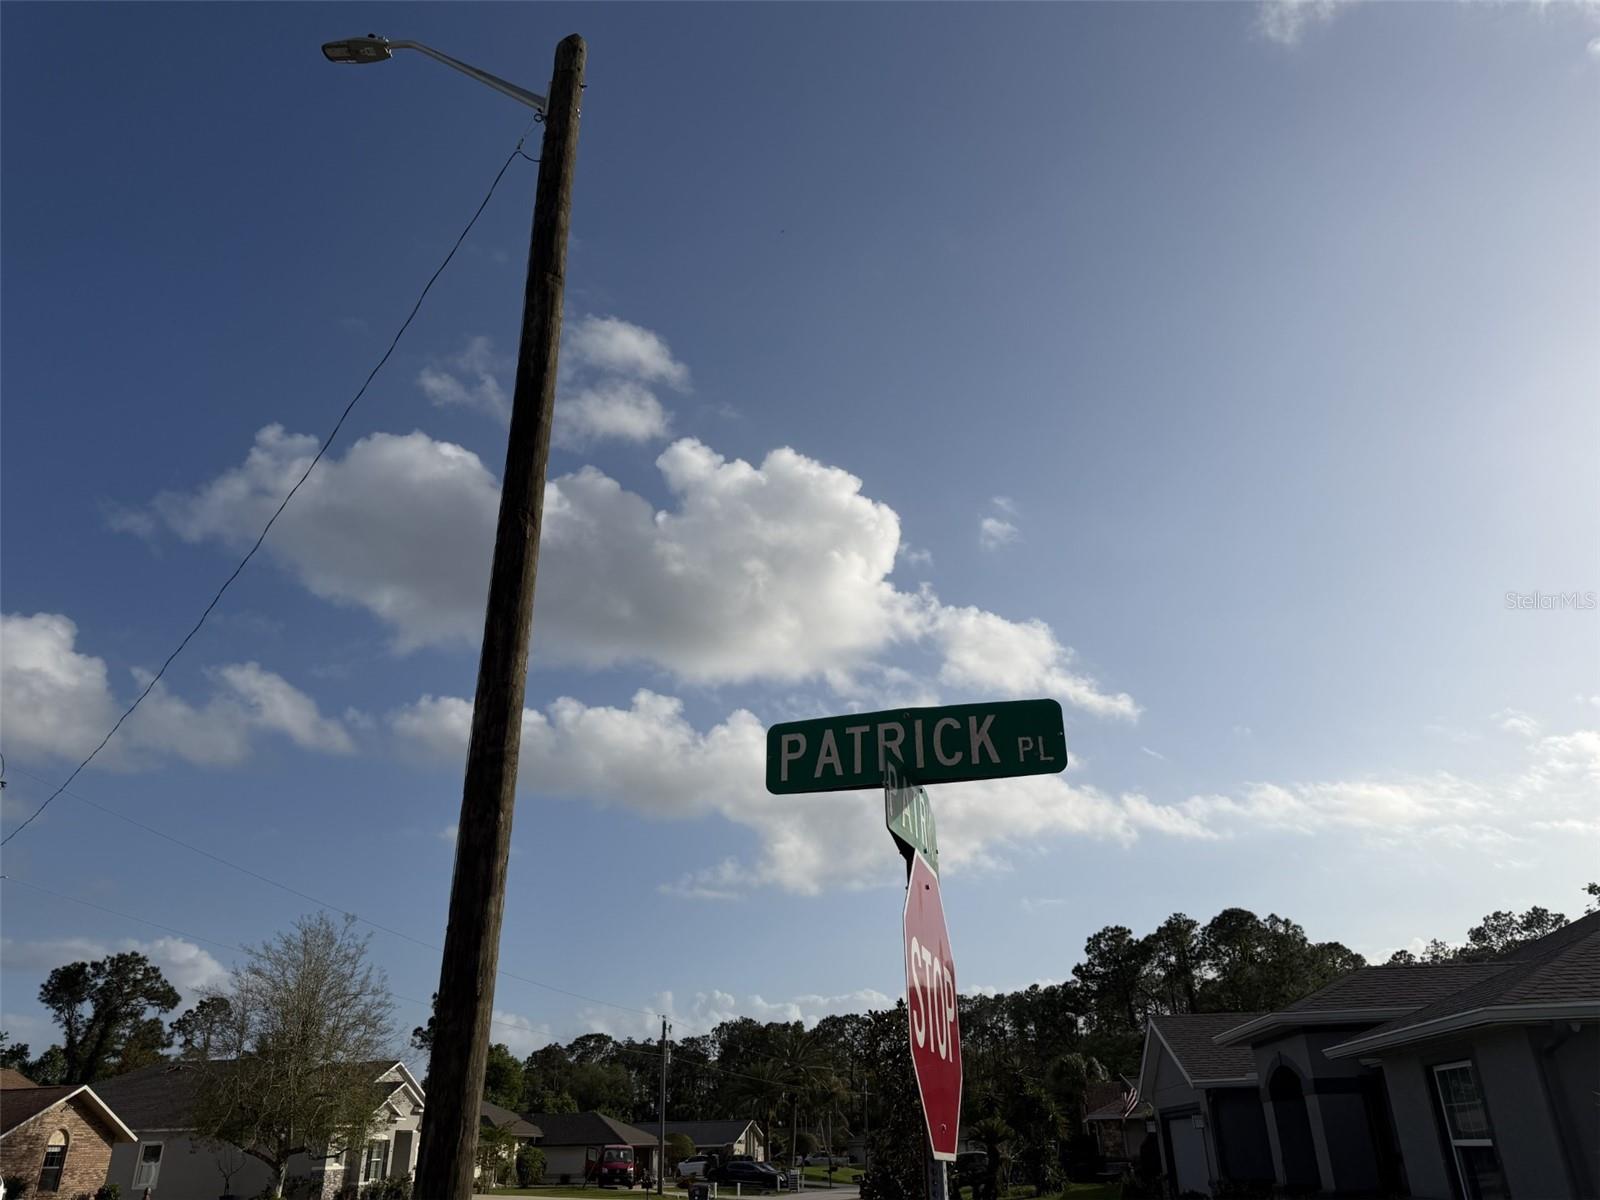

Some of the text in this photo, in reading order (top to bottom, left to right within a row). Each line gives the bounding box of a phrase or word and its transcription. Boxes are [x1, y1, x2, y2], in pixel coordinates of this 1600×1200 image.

[780, 714, 1054, 782] PATRICK PL
[911, 936, 955, 1063] STOP
